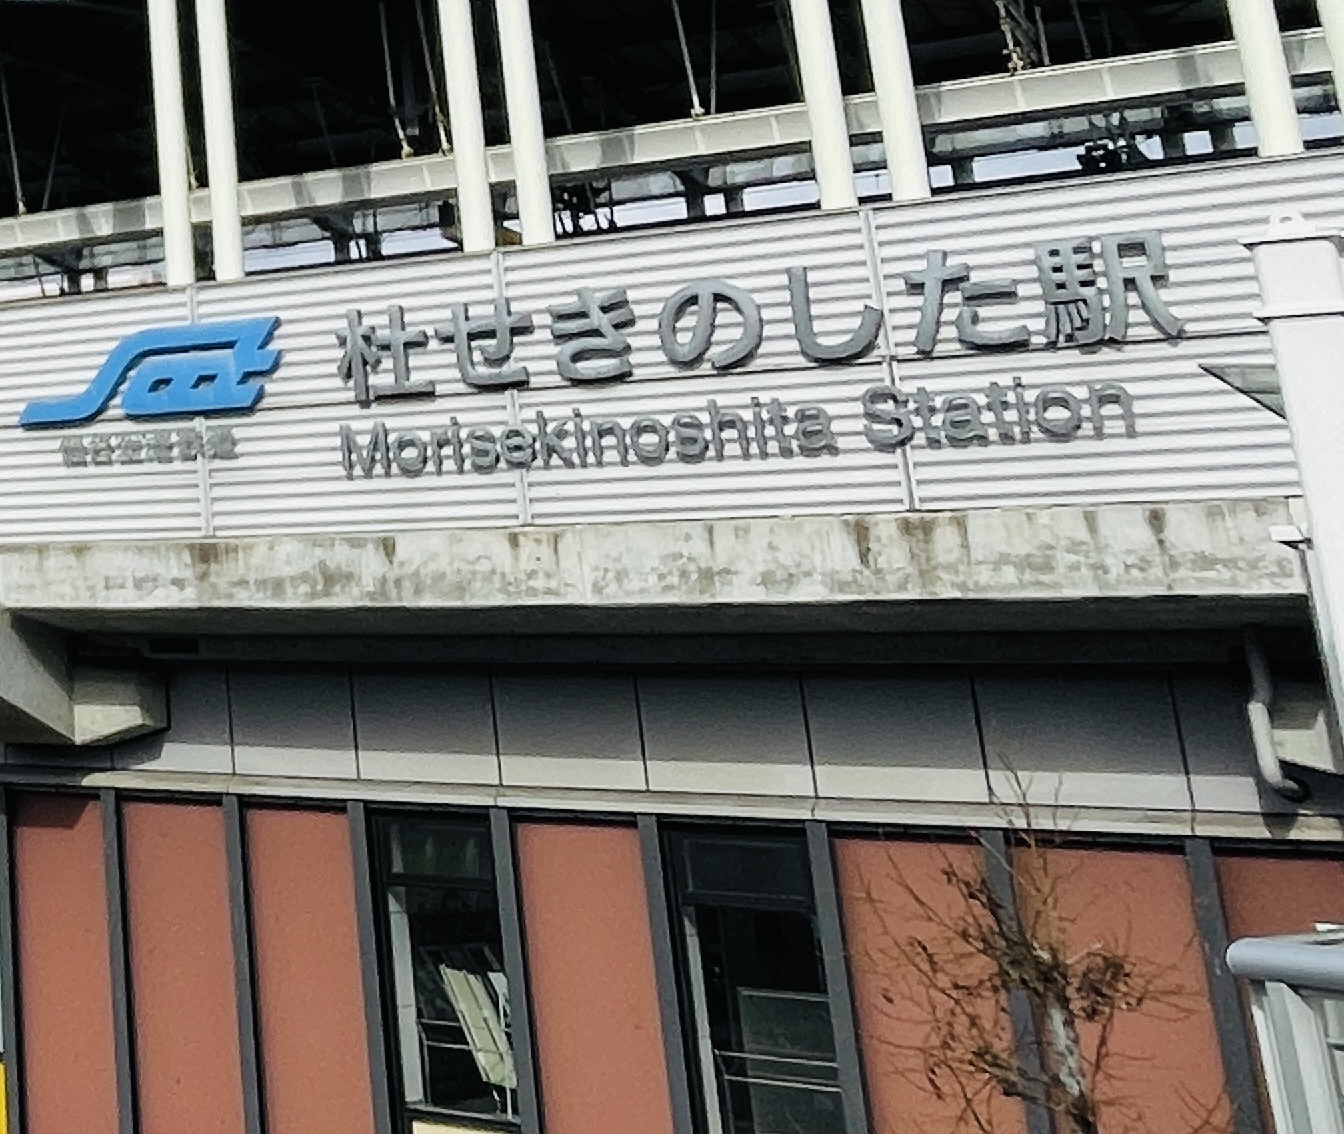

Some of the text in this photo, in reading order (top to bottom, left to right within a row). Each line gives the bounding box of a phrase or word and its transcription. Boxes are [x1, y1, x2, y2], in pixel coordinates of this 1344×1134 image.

[334, 229, 1188, 410] 杜せきのした駅
[338, 376, 1137, 481] Morisekinoshita Station
